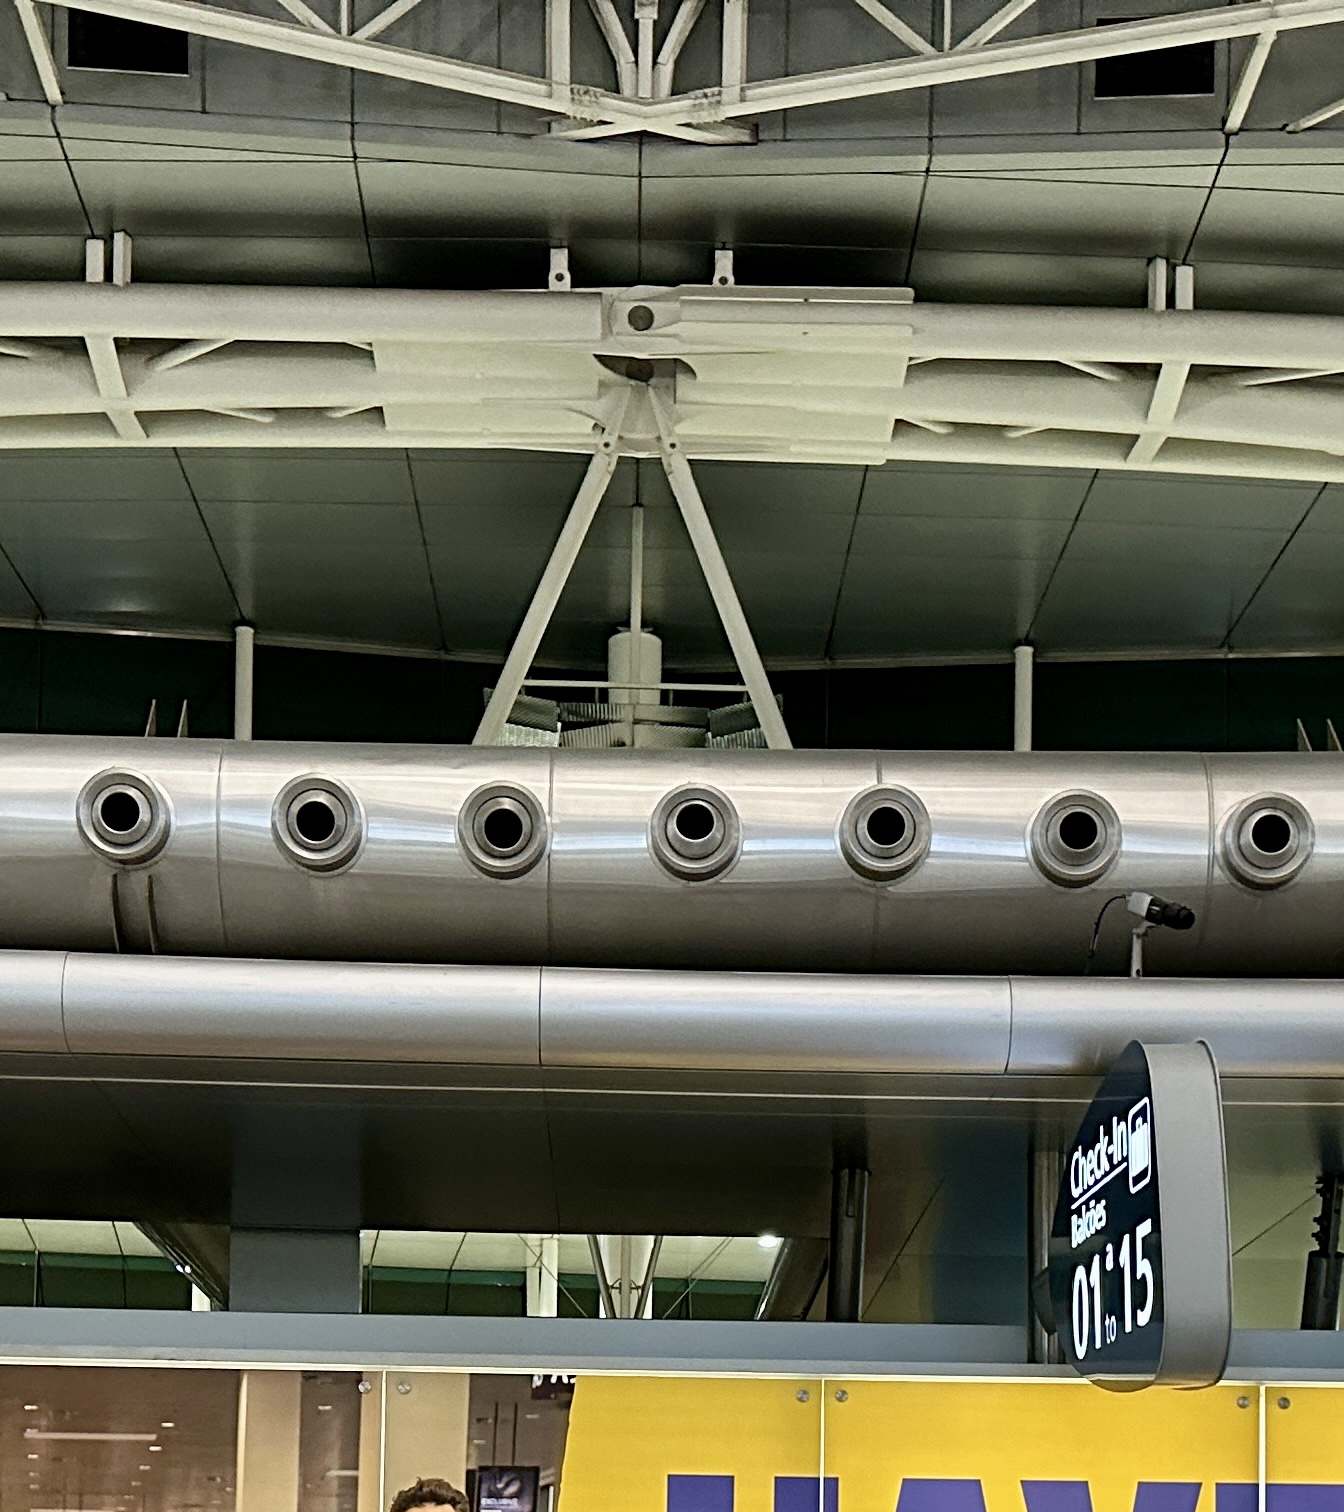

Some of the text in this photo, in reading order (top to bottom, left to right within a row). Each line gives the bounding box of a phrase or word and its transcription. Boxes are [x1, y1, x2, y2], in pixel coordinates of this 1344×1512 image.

[1070, 1116, 1128, 1199] Check-In
[1072, 1253, 1102, 1360] 01
[1119, 1218, 1154, 1334] 15
[1105, 1312, 1117, 1345] to
